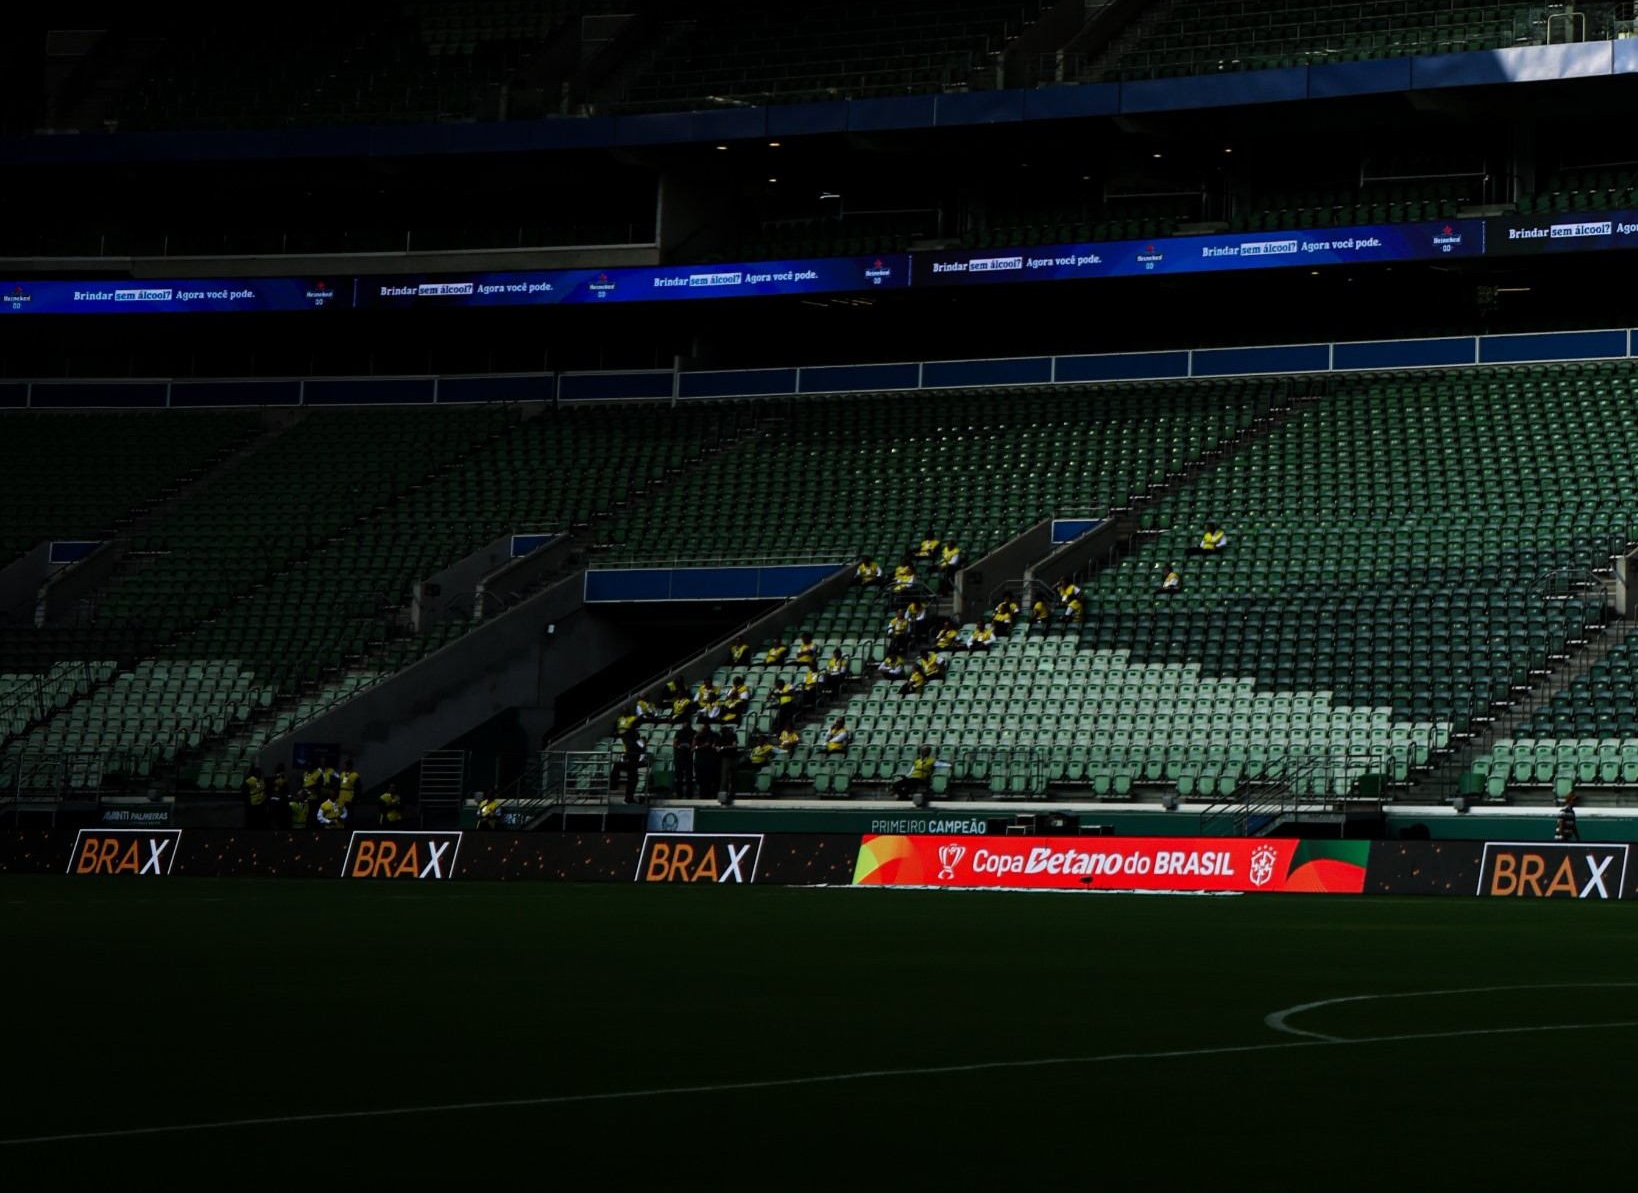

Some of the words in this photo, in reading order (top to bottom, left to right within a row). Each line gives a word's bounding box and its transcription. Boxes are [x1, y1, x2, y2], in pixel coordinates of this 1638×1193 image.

[1508, 228, 1550, 239] Brindar
[1551, 227, 1573, 236] sem
[1574, 224, 1611, 235] álcool?
[1202, 247, 1240, 257] Brindar
[1242, 245, 1261, 254] sem
[1263, 242, 1296, 253] álcool?
[1301, 240, 1330, 252] Agora
[1331, 238, 1354, 249] você
[1356, 238, 1381, 250] pode.
[933, 263, 969, 273] Brindar
[970, 262, 989, 271] sem
[1026, 257, 1053, 268] Agora
[654, 277, 688, 287] Brindar
[690, 277, 709, 286] sem
[745, 273, 771, 284] Agora
[74, 291, 113, 300] Brindar
[115, 292, 136, 300] sem
[176, 291, 205, 301] Agora
[380, 287, 417, 296] Brindar
[419, 286, 438, 295] sem
[477, 284, 504, 294] Agora
[871, 820, 926, 834] PRIMEIRO
[928, 818, 986, 835] CAMPEÃO
[75, 838, 170, 875] BRAX
[352, 840, 450, 879] BRAX
[645, 843, 751, 884] BRAX
[972, 849, 1023, 877] Copa
[1024, 847, 1122, 876] Betano
[1123, 852, 1151, 875] do
[1153, 851, 1235, 876] BRASIL
[1490, 853, 1614, 899] BRAX
